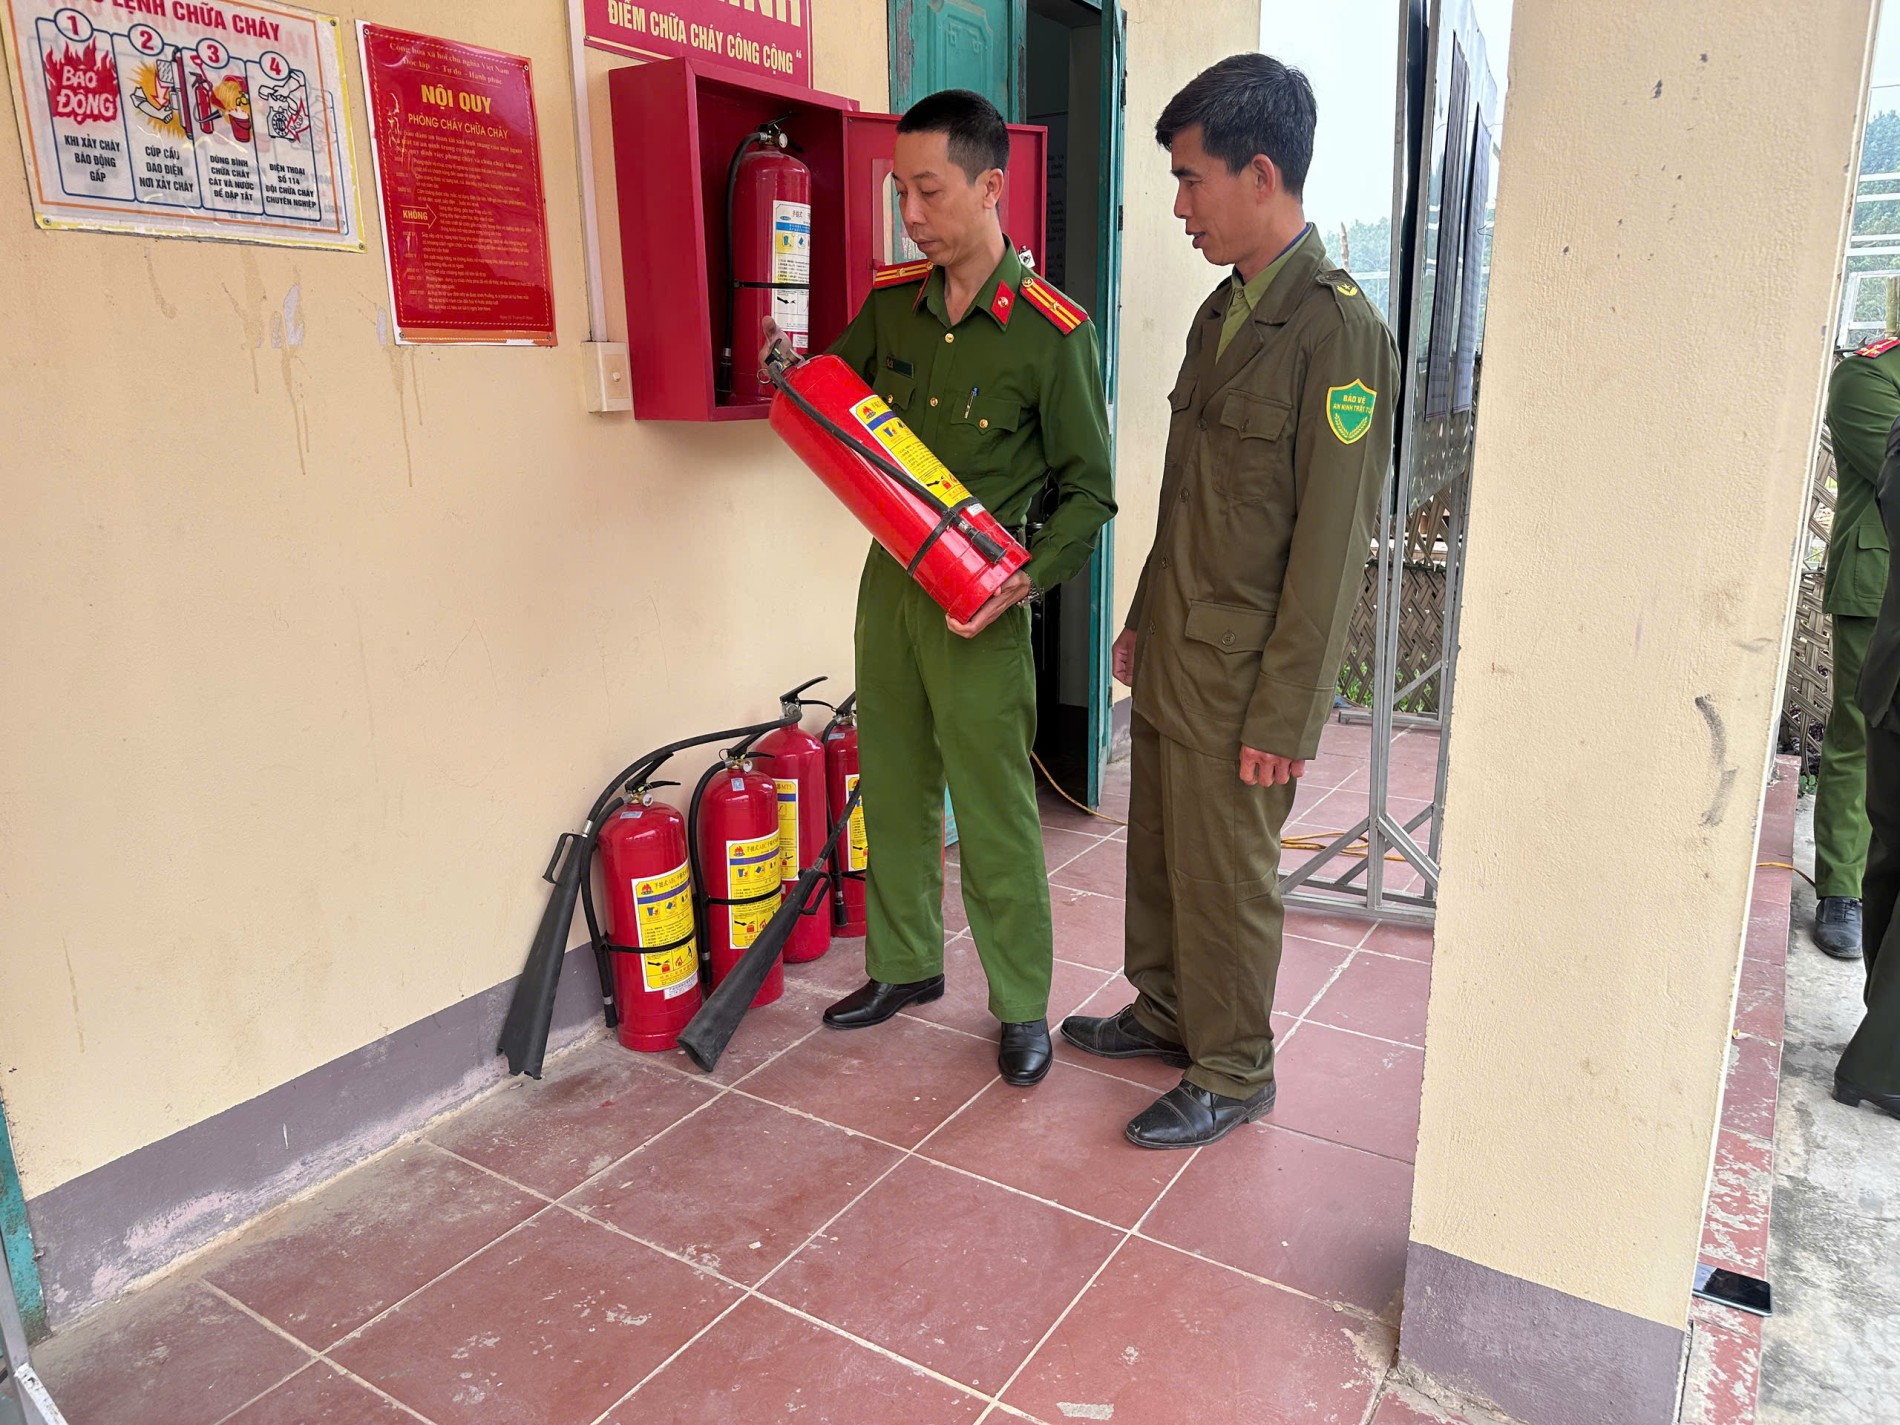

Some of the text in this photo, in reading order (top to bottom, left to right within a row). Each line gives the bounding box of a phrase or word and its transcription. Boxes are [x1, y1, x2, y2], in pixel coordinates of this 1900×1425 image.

[67, 15, 79, 36] 1
[172, 1, 227, 30] CHỮA
[232, 14, 280, 41] CHÁY
[139, 30, 154, 51] 2
[608, 0, 646, 33] ĐIỂM
[650, 11, 687, 44] CHỮA
[690, 23, 723, 54] CHÁY
[726, 33, 760, 65] CÔNG
[763, 43, 793, 75] CỘNG
[206, 44, 220, 63] 3
[269, 57, 282, 75] 4
[56, 89, 115, 118] ĐỘNG
[421, 84, 492, 114] NỘI QUY
[408, 112, 508, 139] PHÒNG CHÁY CHỮA CHÁY
[64, 133, 120, 152] KHI XẢY CHÁY
[145, 145, 162, 158] CÚP
[93, 155, 117, 168] ĐỘNG
[146, 161, 184, 177] DAO ĐIỆN
[210, 154, 249, 168] DÙNG BÌNH
[89, 168, 106, 183] GẤP
[211, 165, 250, 179] CHỮA CHÁY
[269, 163, 306, 176] ĐIỆN THOẠI
[139, 175, 194, 193] NƠI XẢY CHÁY
[208, 177, 254, 191] CÁT VÀ NƯỚC
[289, 177, 300, 185] 114
[278, 185, 297, 196] CHỮA
[297, 187, 314, 198] CHÁY
[266, 195, 317, 209] CHUYÊN NGHIỆP
[402, 209, 428, 220] KHÔNG
